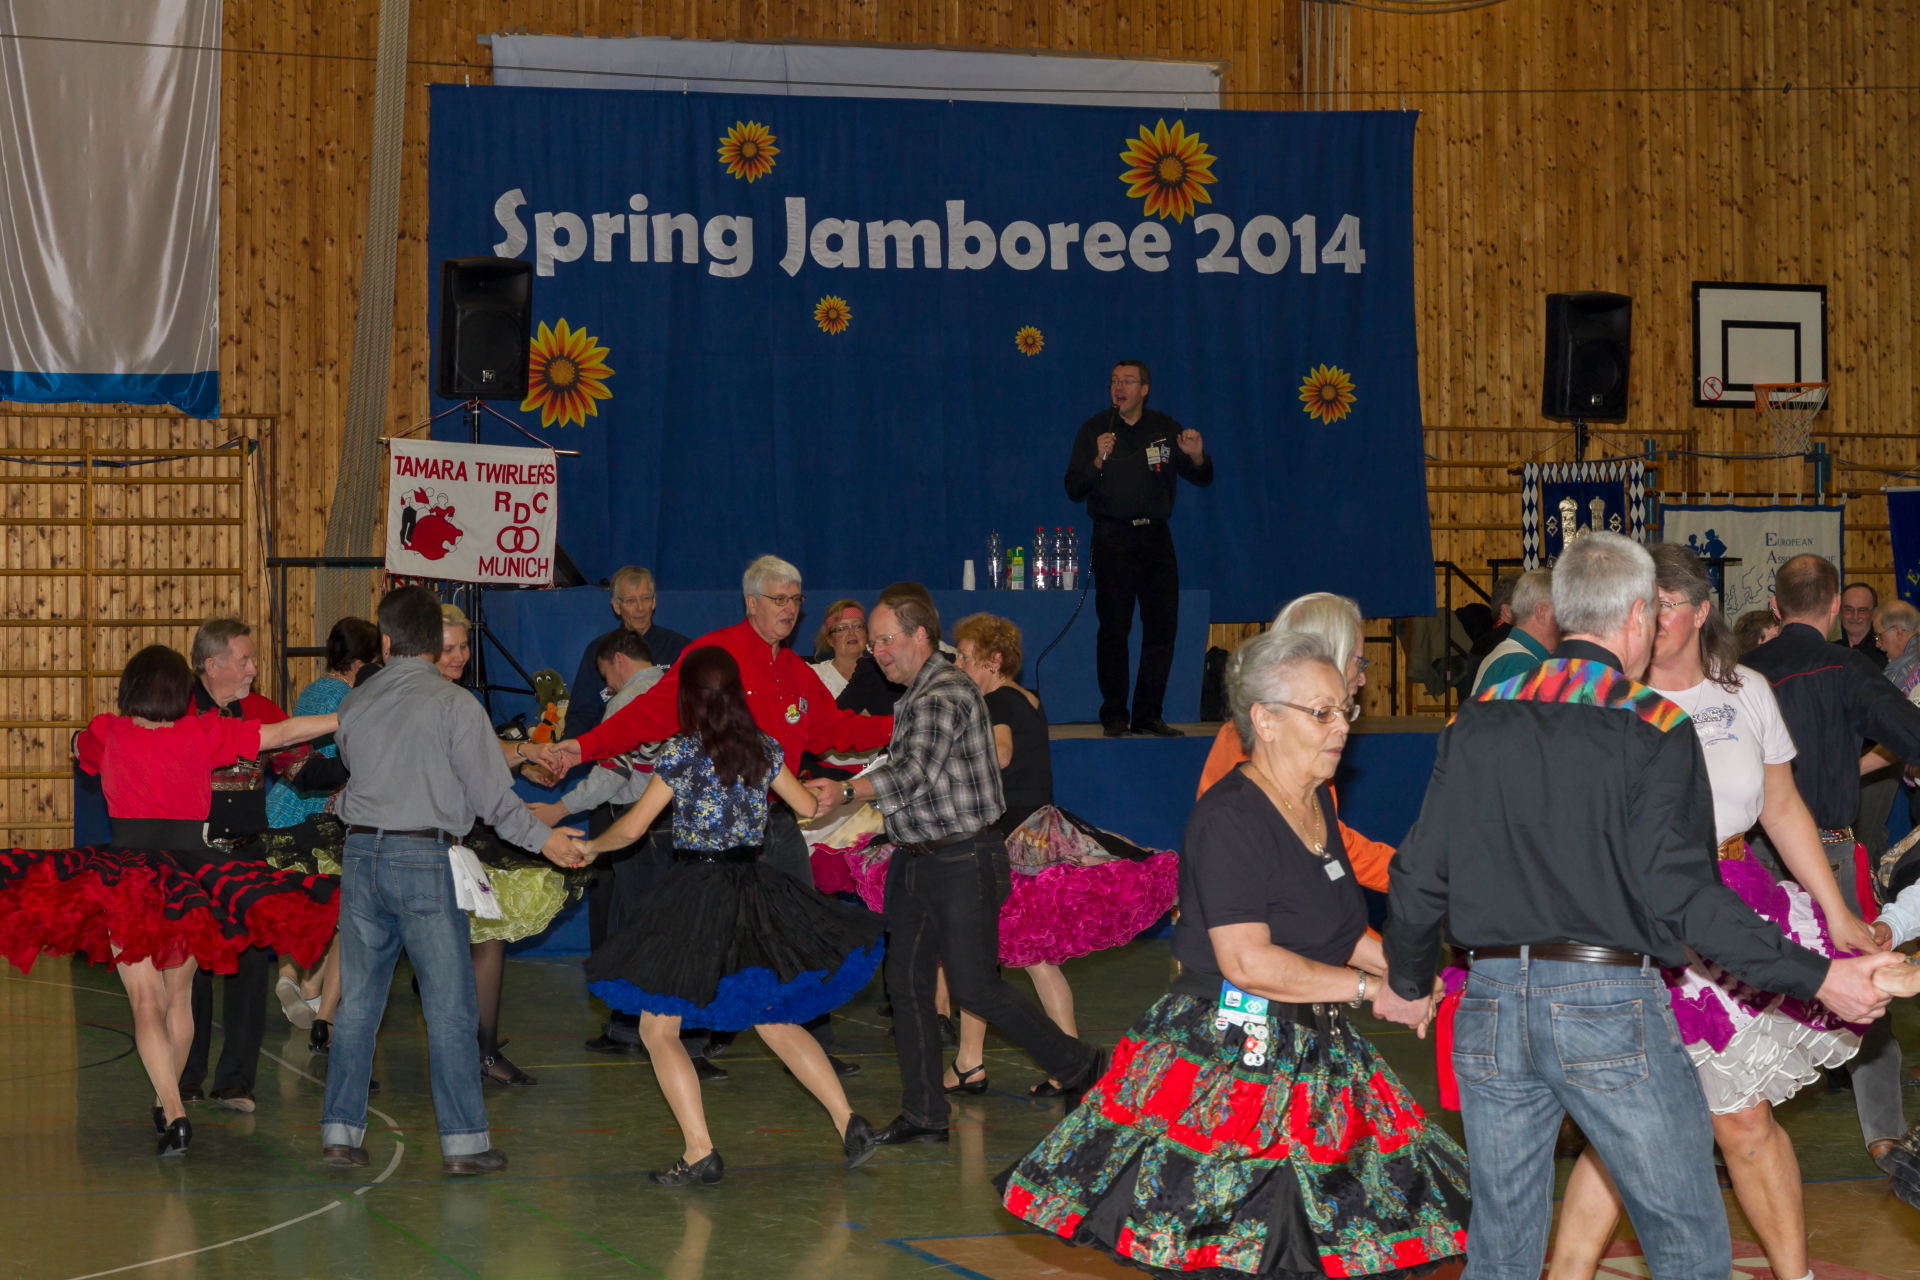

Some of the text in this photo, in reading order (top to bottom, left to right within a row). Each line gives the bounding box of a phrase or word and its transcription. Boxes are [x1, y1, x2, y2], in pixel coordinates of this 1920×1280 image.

[493, 188, 1366, 277] Spring Jamboree 2014
[394, 455, 556, 485] TAMARA TWIRLERS
[1765, 532, 1813, 547] EUROPEAN
[478, 555, 549, 578] MUNICH
